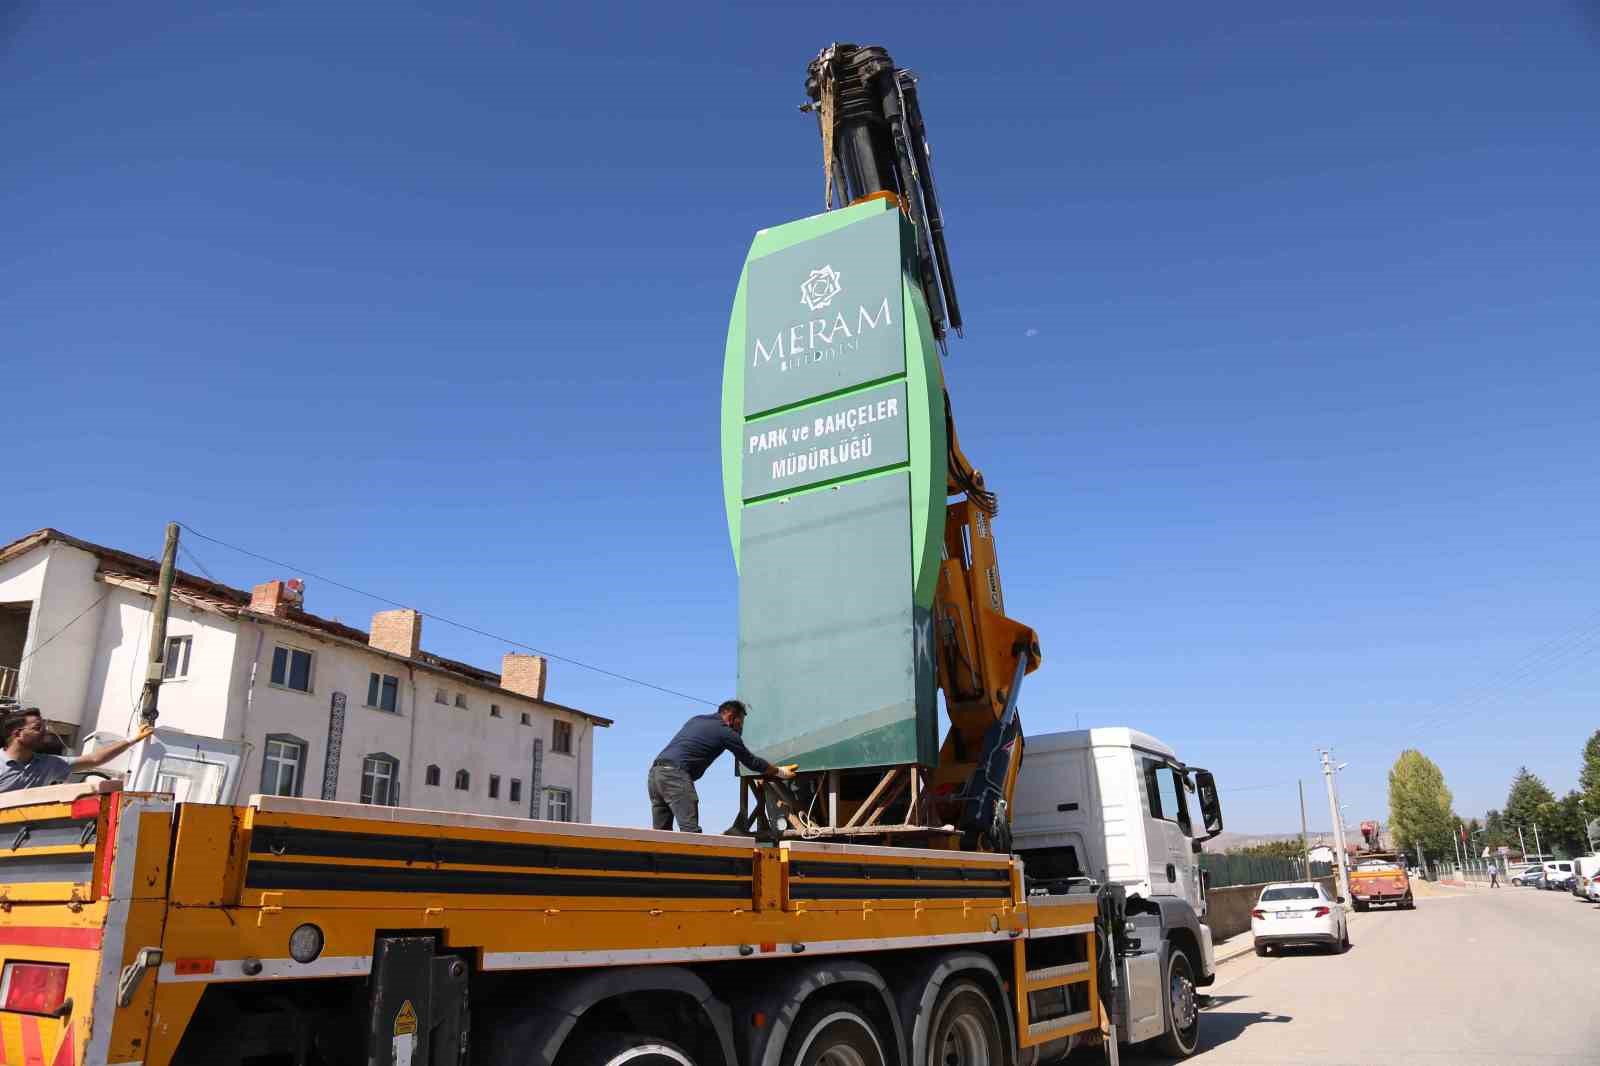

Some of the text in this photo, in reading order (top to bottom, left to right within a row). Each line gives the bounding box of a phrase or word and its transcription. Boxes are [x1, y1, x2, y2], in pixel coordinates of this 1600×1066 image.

[753, 298, 892, 367] MERAM
[749, 398, 898, 453] PARK ve BAHÇELER
[772, 433, 872, 480] MÜDÜRLÜĞÜ
